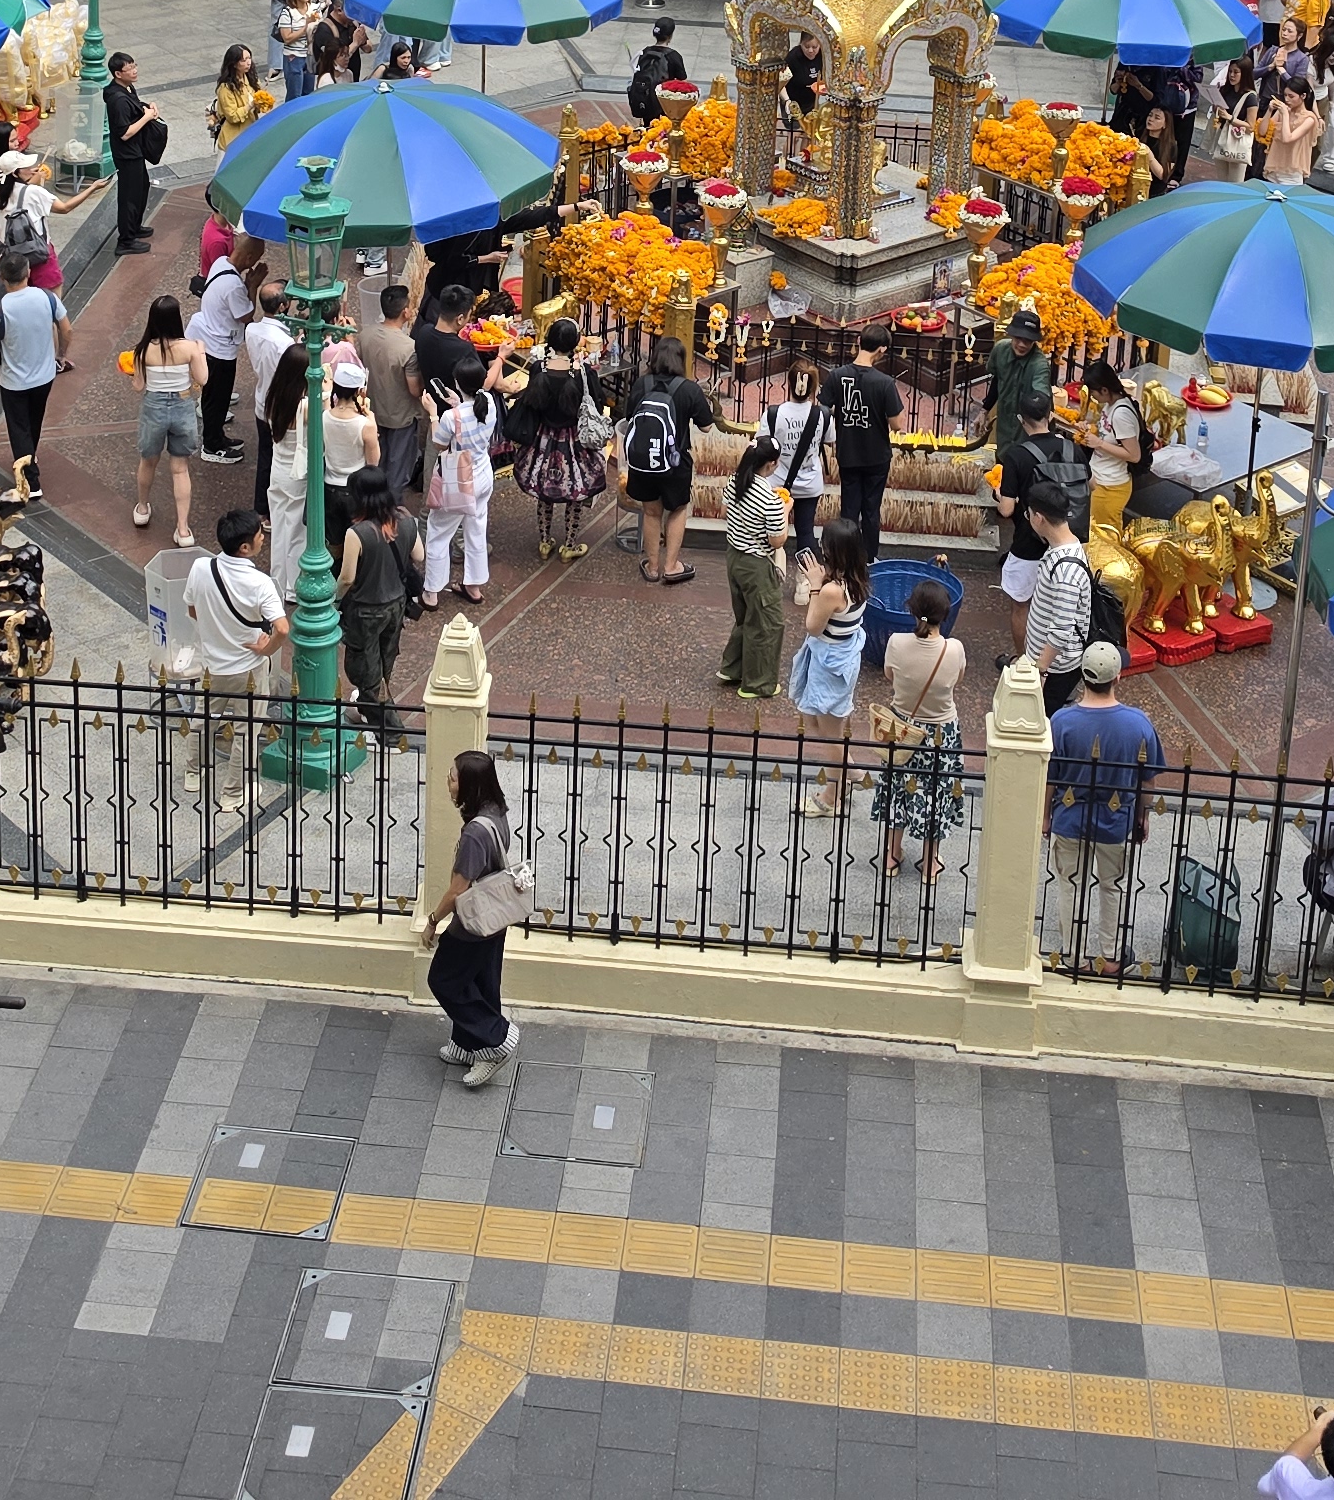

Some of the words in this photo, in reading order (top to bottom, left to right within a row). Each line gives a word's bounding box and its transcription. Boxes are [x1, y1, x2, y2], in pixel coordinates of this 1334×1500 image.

[1219, 148, 1246, 160] BONES
[841, 376, 869, 429] LA
[787, 432, 803, 441] no
[648, 438, 661, 469] FILA
